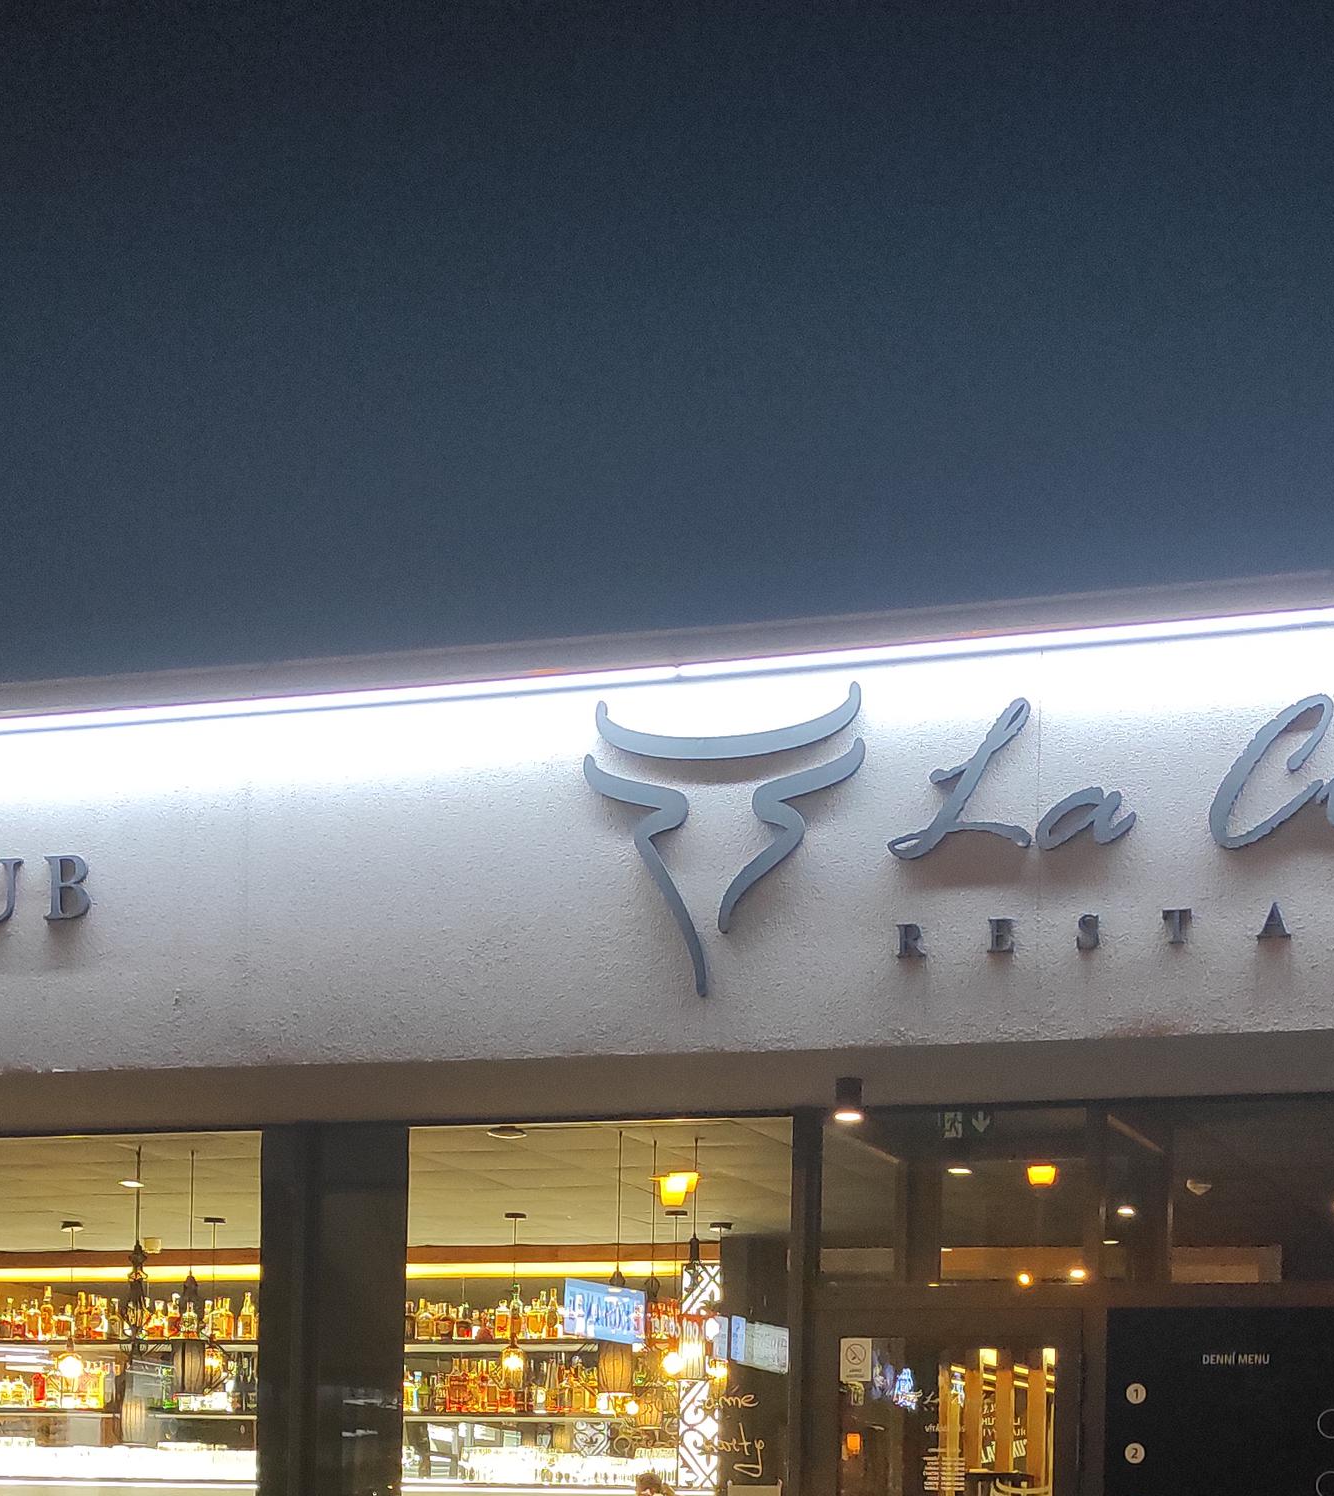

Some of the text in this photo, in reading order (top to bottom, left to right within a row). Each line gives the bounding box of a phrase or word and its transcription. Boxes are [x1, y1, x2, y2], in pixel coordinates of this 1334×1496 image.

[886, 697, 1137, 860] La
[1202, 1351, 1270, 1365] DENNÍ MENU
